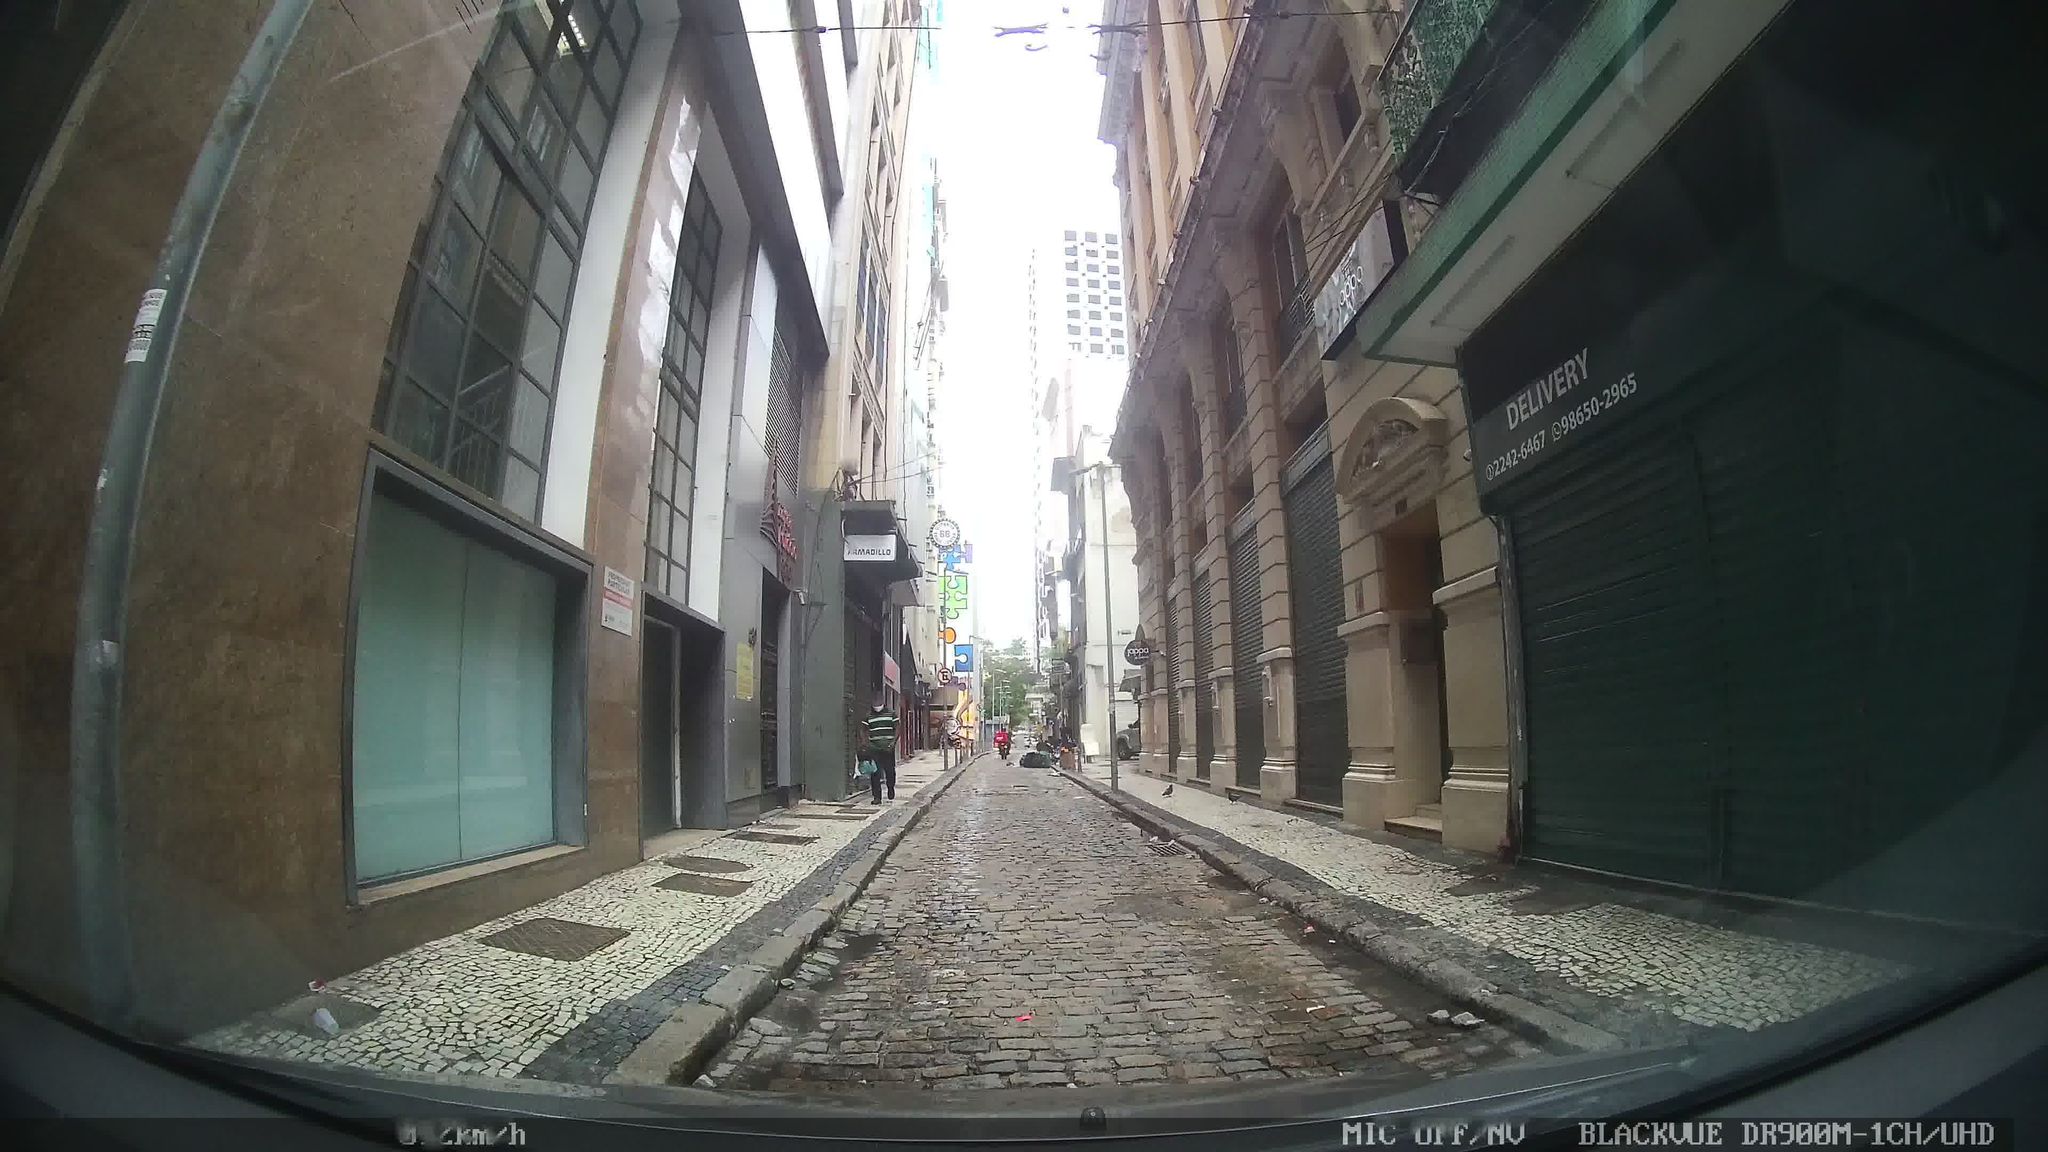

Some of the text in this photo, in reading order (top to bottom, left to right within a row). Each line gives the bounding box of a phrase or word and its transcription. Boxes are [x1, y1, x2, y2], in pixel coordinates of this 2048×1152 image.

[1493, 372, 1638, 478] 2242-6467 98650-2965
[1505, 347, 1589, 431] DELIVERY
